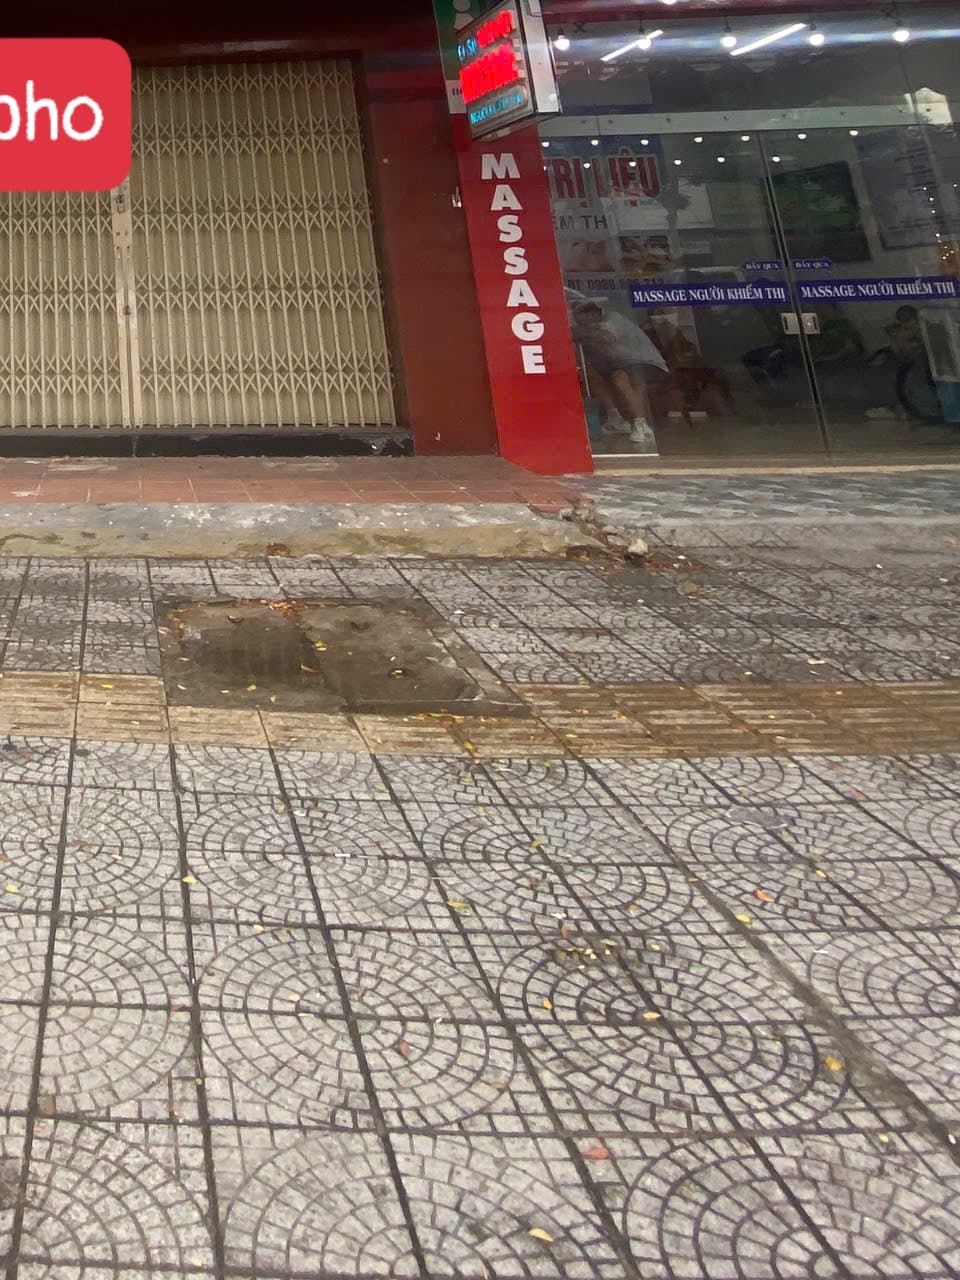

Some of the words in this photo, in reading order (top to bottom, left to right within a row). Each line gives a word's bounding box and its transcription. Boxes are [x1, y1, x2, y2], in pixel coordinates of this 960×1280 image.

[480, 153, 547, 376] MASSAGE
[633, 289, 688, 303] MASSAGE
[689, 285, 725, 302] NGƯỜI
[765, 287, 786, 302] THỊ
[800, 284, 857, 298] MASSAGE
[857, 280, 895, 296] NGƯỜI
[934, 281, 957, 296] THỊ
